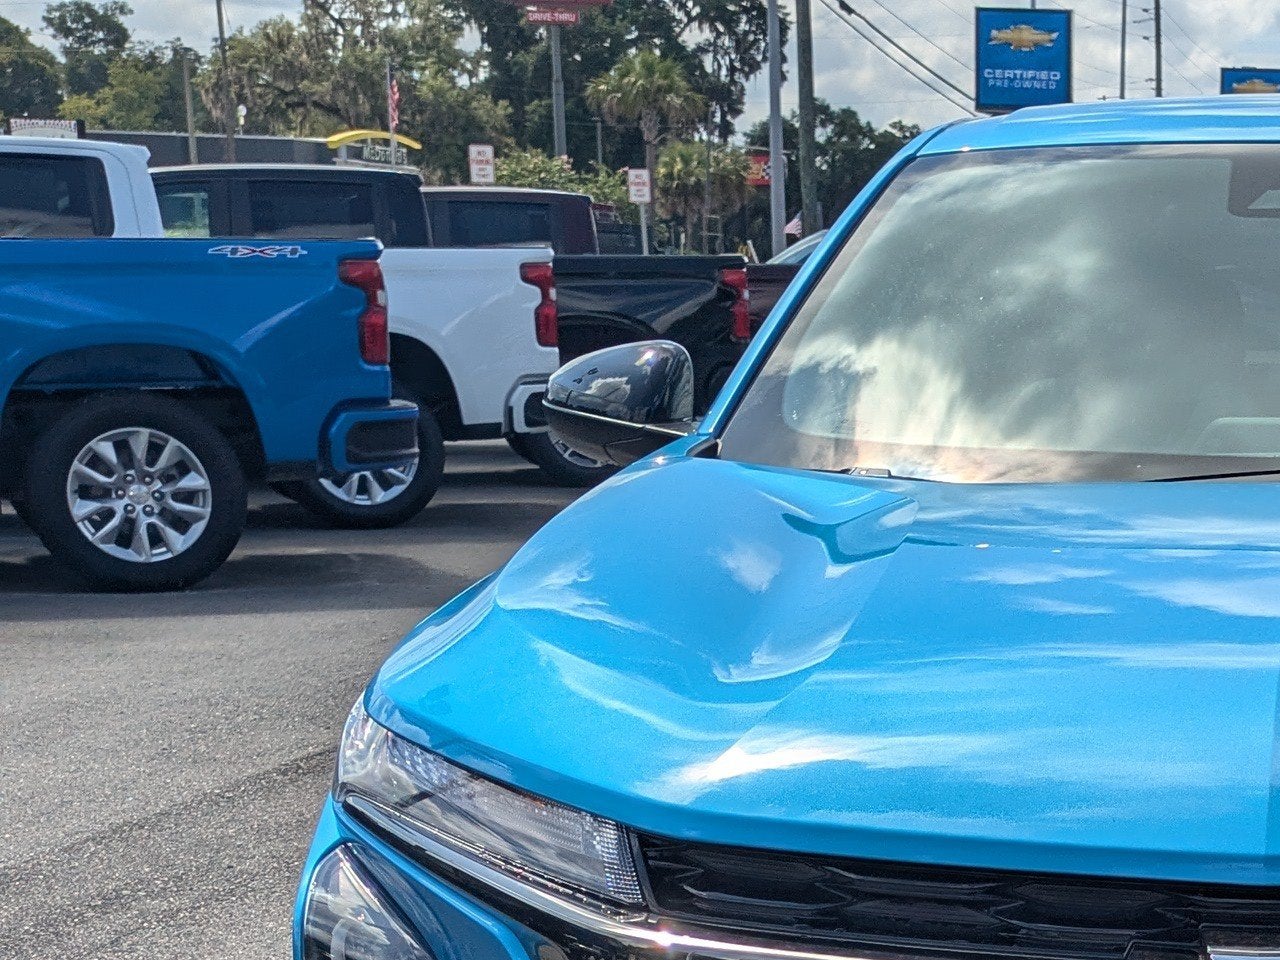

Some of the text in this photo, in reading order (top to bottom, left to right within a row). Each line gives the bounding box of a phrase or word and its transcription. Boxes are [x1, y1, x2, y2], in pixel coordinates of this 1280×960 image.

[528, 12, 576, 21] DRIVE-THRU
[983, 68, 1061, 80] CERTIFIED
[988, 79, 1057, 90] PRE-OWNED
